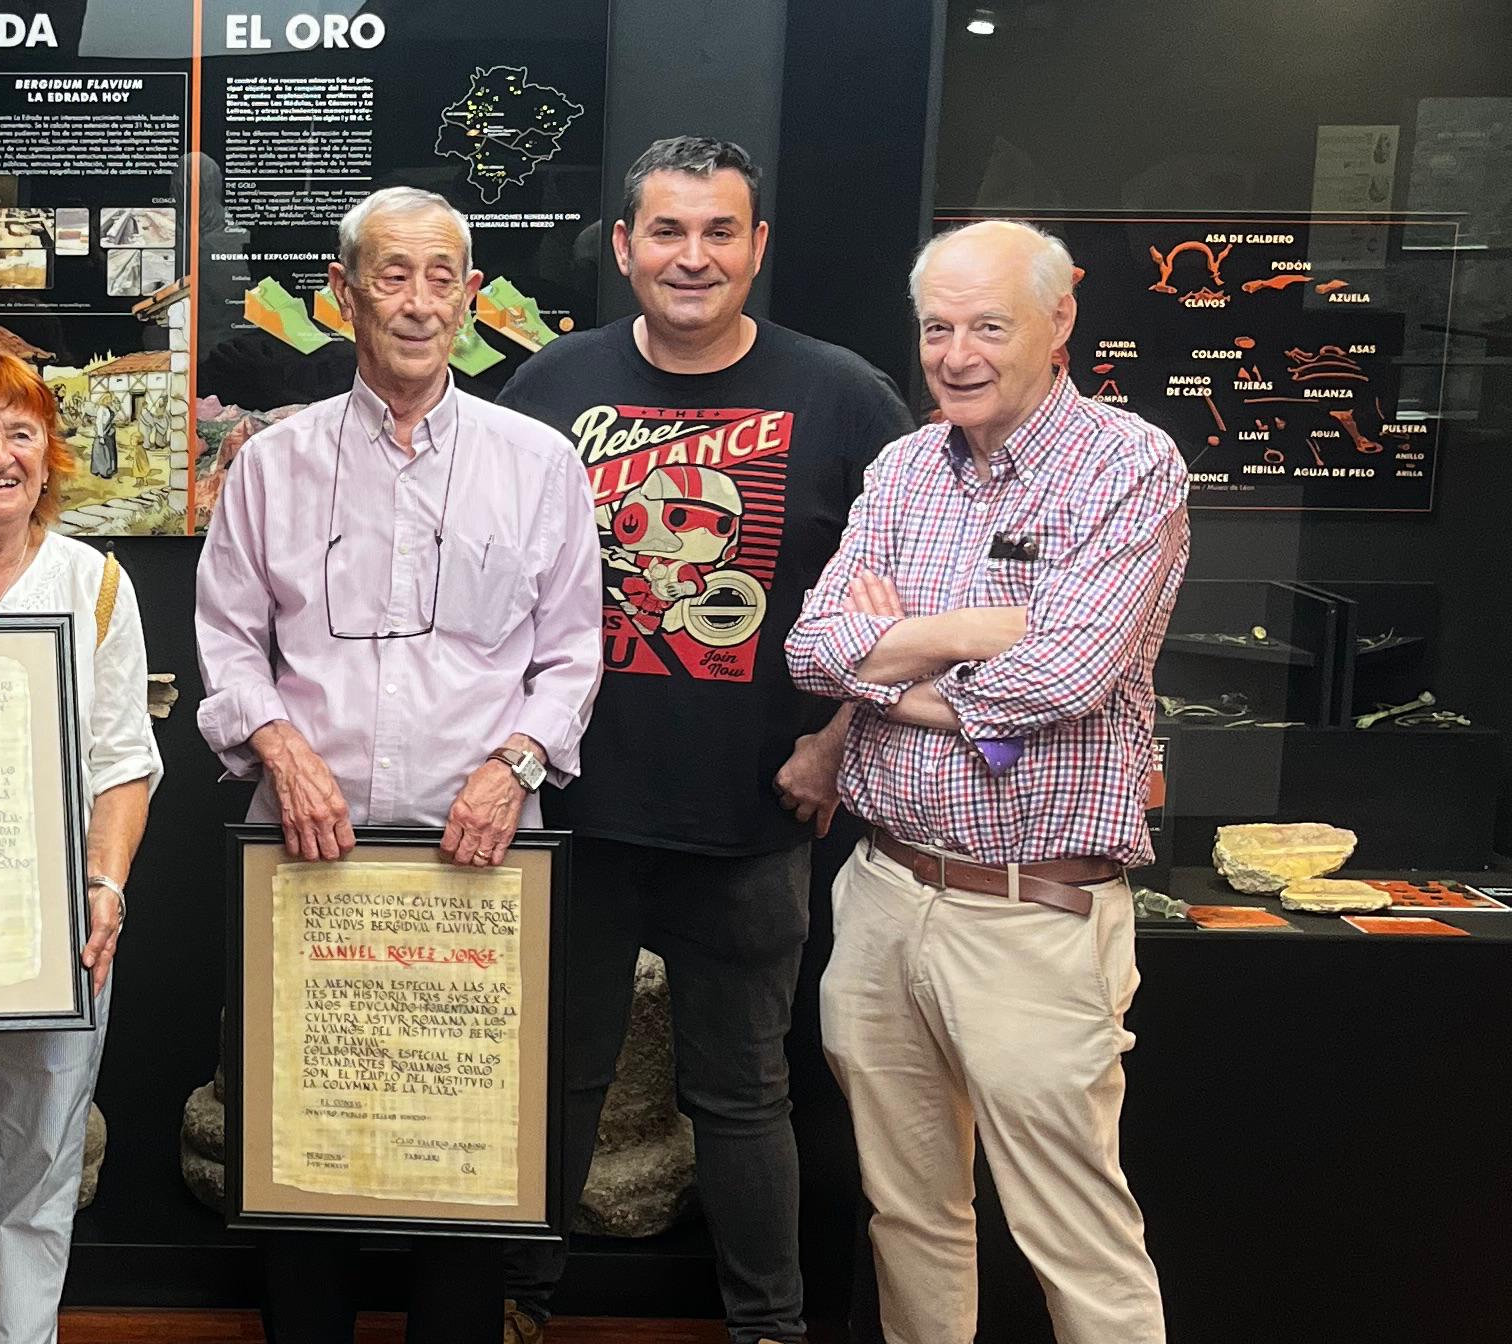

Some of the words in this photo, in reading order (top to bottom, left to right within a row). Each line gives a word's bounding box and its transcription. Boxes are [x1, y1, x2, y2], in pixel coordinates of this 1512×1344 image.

[226, 15, 271, 48] EL
[286, 13, 385, 49] ORO
[15, 79, 82, 89] BERGIDUM
[87, 79, 143, 89] FLAVIUM
[27, 92, 43, 102] LA
[48, 92, 98, 102] EDRADA
[102, 92, 130, 102] HOY
[1205, 234, 1226, 243] ASA
[1229, 235, 1243, 243] DE
[1246, 235, 1294, 244] CALDERO
[264, 252, 319, 260] EXPLOTACIÓN
[1271, 260, 1312, 270] PODÓN
[1329, 293, 1370, 302] AZUELA
[1185, 299, 1226, 308] CLAVOS
[1099, 341, 1136, 349] GUARDA
[1349, 345, 1376, 354] ASAS
[1095, 350, 1107, 358] DE
[1109, 349, 1138, 358] PUÑAL
[1191, 350, 1242, 359] COLADOR
[1168, 376, 1211, 385] MANGO
[1234, 381, 1273, 390] TIJERAS
[1166, 387, 1181, 396] DE
[1183, 387, 1212, 396] CAZO
[1304, 389, 1353, 398] BALANZA
[658, 409, 705, 419] THE
[1382, 424, 1427, 433] PULSERA
[571, 405, 710, 464] Rebel
[1238, 432, 1270, 440] LLAVE
[1310, 431, 1340, 439] AGUJA
[593, 410, 786, 502] LLIANCE
[1243, 465, 1286, 474] HEBILLA
[1294, 468, 1329, 477] AGUJA
[1332, 468, 1346, 477] DE
[1349, 468, 1375, 477] PELO
[1188, 473, 1229, 482] BRONCE
[699, 649, 737, 666] Join
[707, 663, 745, 677] Now
[304, 895, 319, 905] LA
[325, 894, 405, 906] ASOCIACION
[481, 900, 495, 910] DE
[303, 906, 364, 919] CREACION
[329, 919, 364, 931] LVDVS
[303, 932, 332, 942] CEDE
[310, 944, 376, 959] MANVEL
[443, 948, 497, 968] JORGE
[305, 979, 319, 989] LA
[324, 979, 384, 990] MENCION
[391, 980, 444, 991] ESPECIAL
[450, 982, 459, 991] A
[464, 982, 484, 992] LAS
[306, 990, 327, 999] TES
[332, 990, 347, 1000] EN
[353, 990, 407, 1002] HISTORIA
[457, 1052, 473, 1063] EN
[338, 1069, 350, 1079] EL
